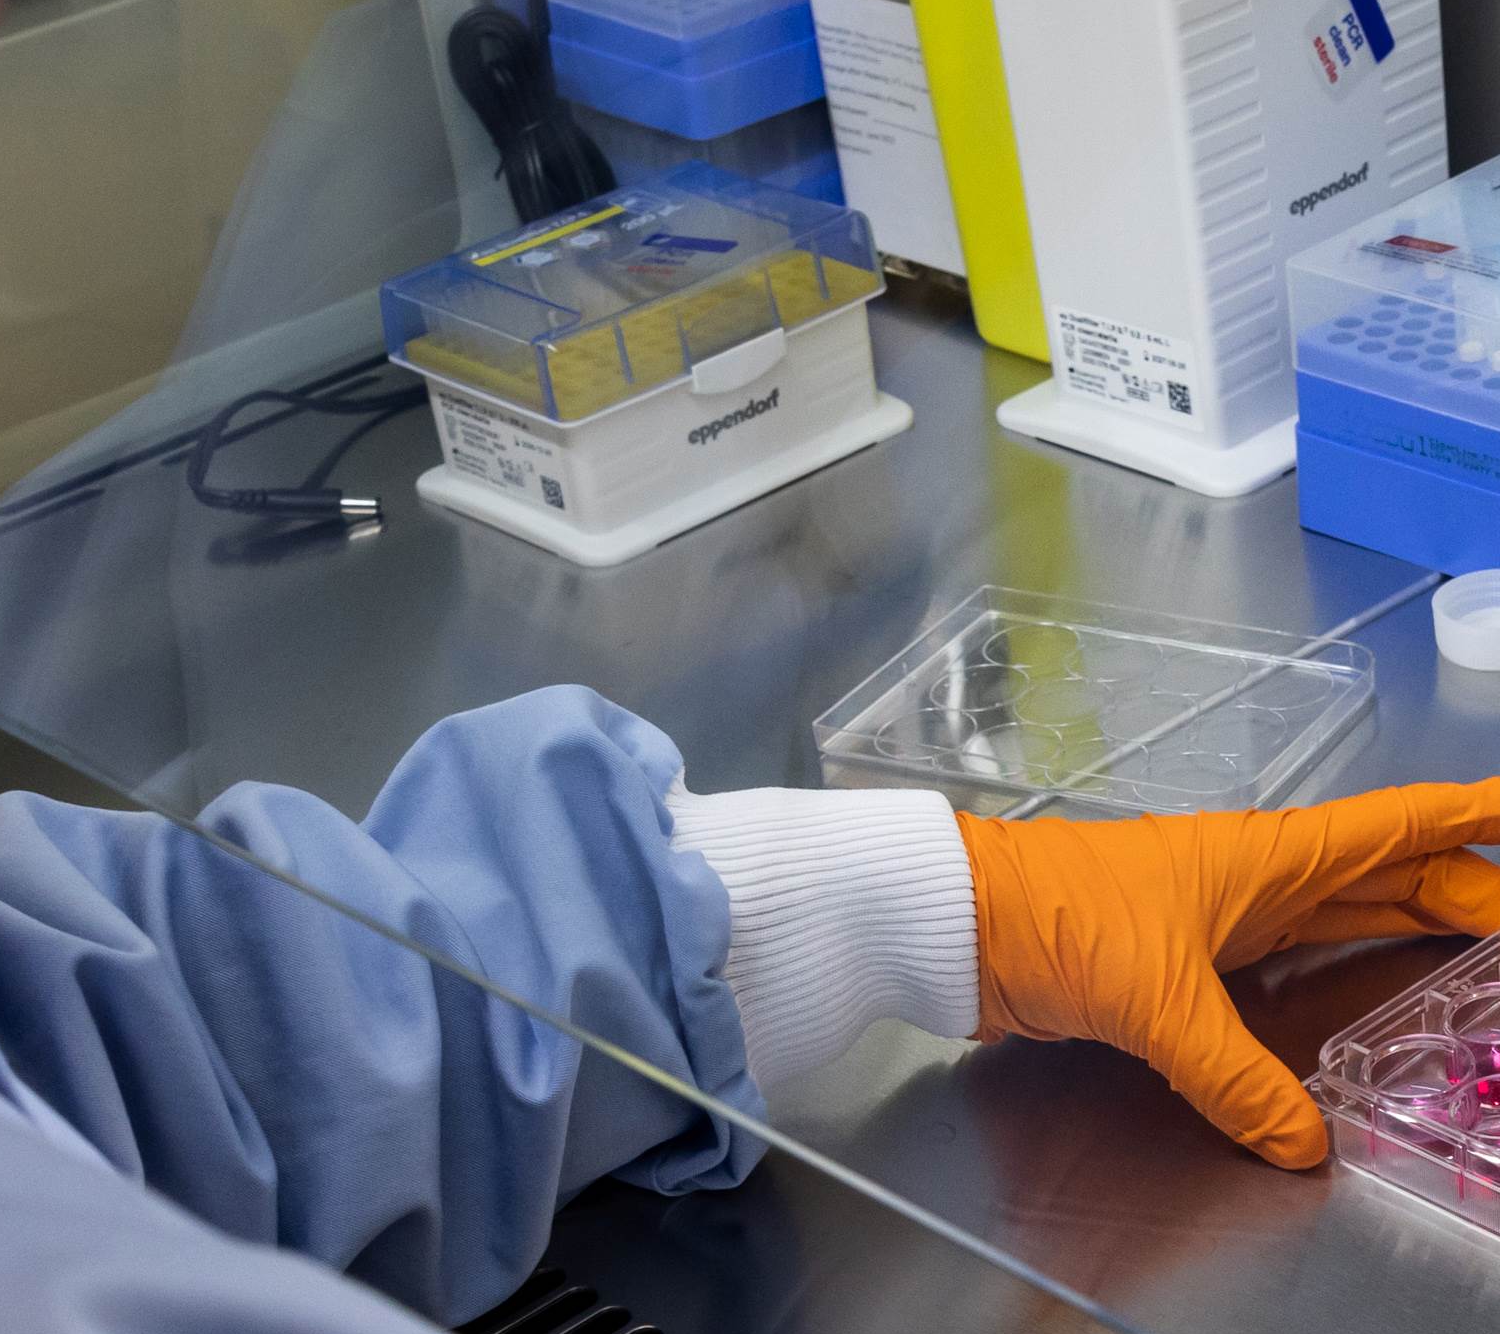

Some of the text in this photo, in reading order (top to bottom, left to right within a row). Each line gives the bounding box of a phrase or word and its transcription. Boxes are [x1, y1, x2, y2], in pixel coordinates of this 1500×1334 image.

[1328, 25, 1351, 67] clean
[1342, 13, 1365, 51] PCR
[1313, 36, 1339, 85] sterile
[1288, 161, 1370, 217] eppendorf
[687, 387, 780, 445] eppendorf
